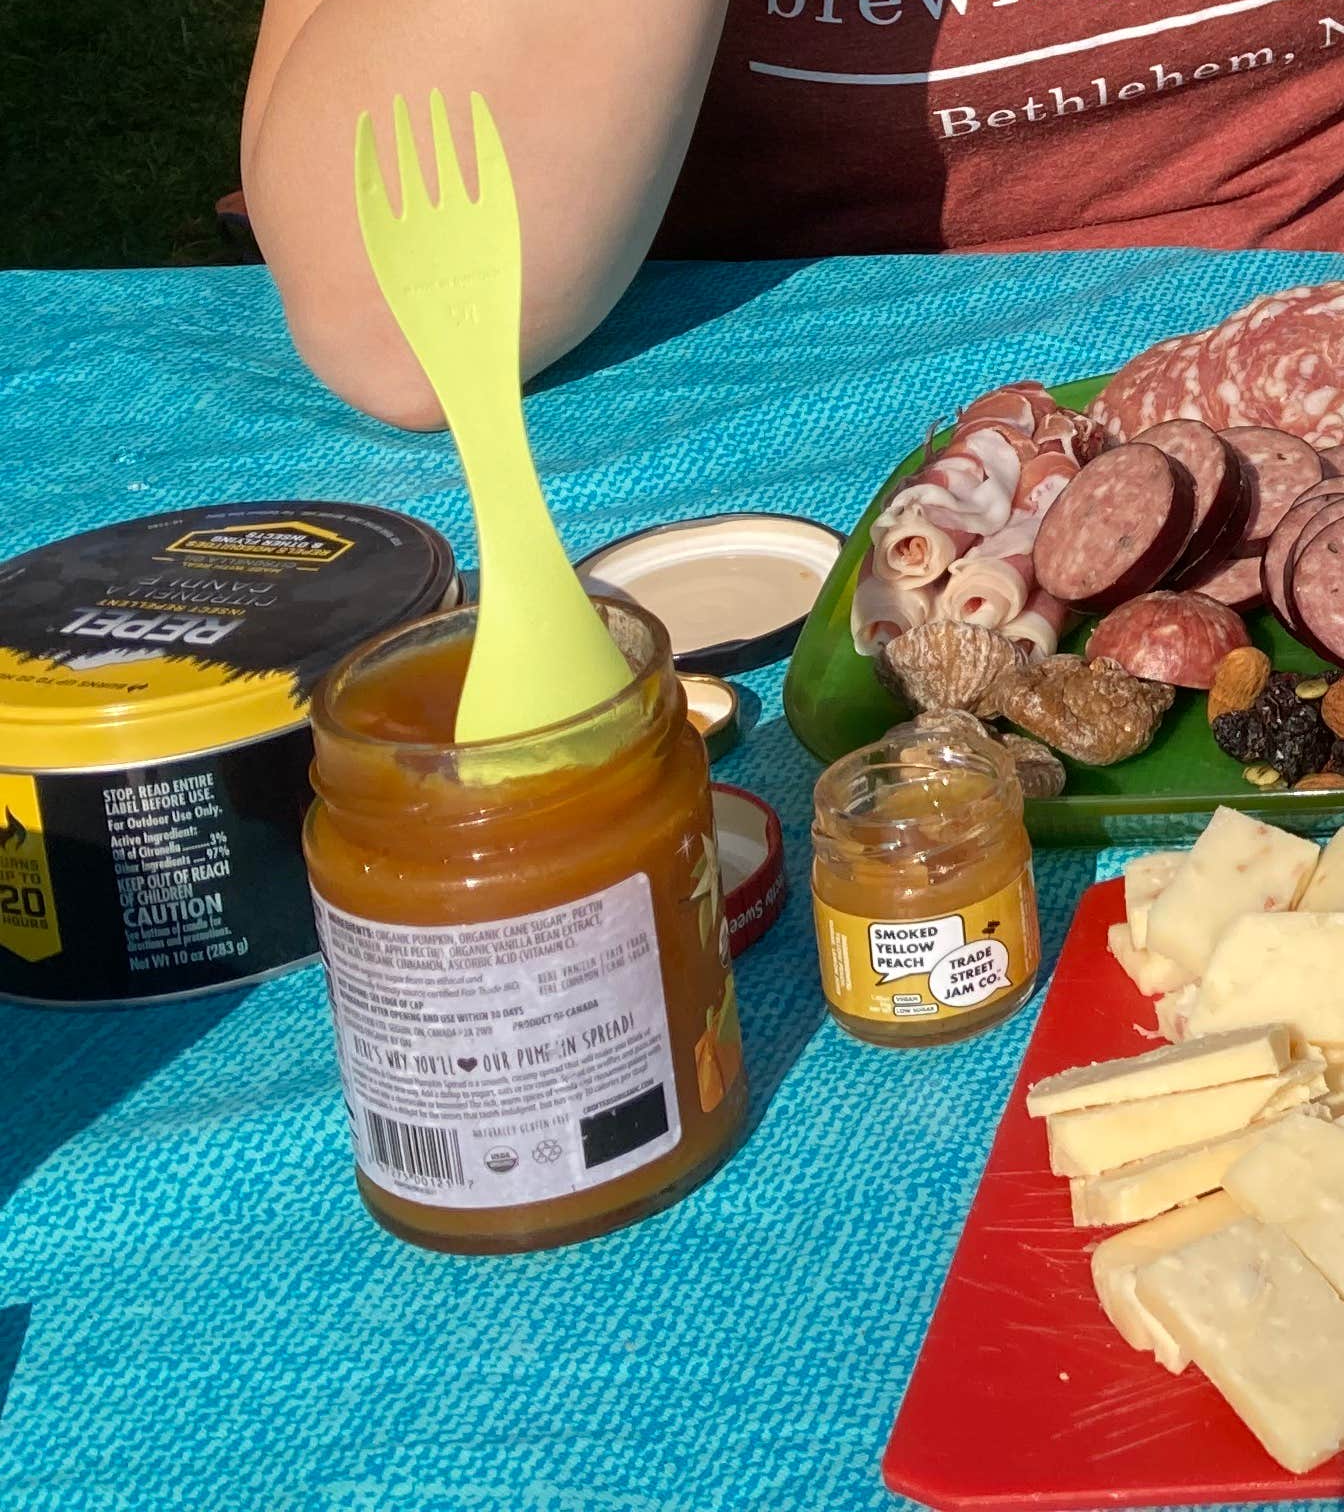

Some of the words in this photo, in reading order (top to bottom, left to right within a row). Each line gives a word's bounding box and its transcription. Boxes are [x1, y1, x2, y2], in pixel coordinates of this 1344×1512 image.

[934, 41, 1297, 139] Bethlehem,
[106, 586, 279, 608] CITRONELLA
[140, 576, 277, 594] CANDLE
[96, 598, 188, 613] REPELLENT
[189, 603, 247, 616] INSECT
[59, 606, 247, 645] REPEL
[138, 782, 170, 799] READ
[173, 773, 214, 793] ENTIRE
[105, 800, 140, 816] LABEL
[142, 793, 187, 811] BEFORE
[189, 787, 215, 804] USE.
[108, 818, 125, 832] For
[127, 814, 169, 829] Outdoor
[172, 809, 192, 823] Use
[195, 802, 223, 818] Only.
[111, 834, 141, 849] Active
[117, 874, 145, 892] KEEP
[147, 871, 171, 889] OUT
[173, 868, 188, 885] OF
[191, 859, 231, 883] REACH
[0, 884, 46, 918] 20
[120, 892, 134, 908] OF
[137, 883, 194, 906] CHILDREN
[123, 892, 223, 928] CAUTION
[730, 899, 763, 934] Swee
[450, 943, 492, 958] ORGANIC
[493, 936, 533, 954] VANILLA
[535, 929, 560, 945] BEAN
[459, 928, 499, 944] ORGANIC
[503, 922, 528, 938] CANE
[874, 926, 939, 941] SMOKED
[129, 957, 150, 972] Net
[152, 953, 170, 969] Wt
[173, 949, 188, 966] 10
[206, 940, 235, 962] (283
[448, 954, 493, 970] ASCORBIC
[496, 950, 517, 965] ACID
[519, 942, 563, 964] (VITAMIN
[875, 941, 935, 955] YELLOW
[949, 946, 992, 970] TRADE
[877, 957, 925, 969] PEACH
[950, 959, 995, 984] STREET
[944, 983, 975, 1000] JAM
[457, 1011, 489, 1023] WITHIN
[503, 1006, 524, 1018] DAYS
[513, 1013, 553, 1032] PRODUCT
[386, 1049, 408, 1071] WHY
[414, 1055, 456, 1076] YOU'LL
[483, 1050, 511, 1073] OUR
[582, 1012, 635, 1048] SPREAD!
